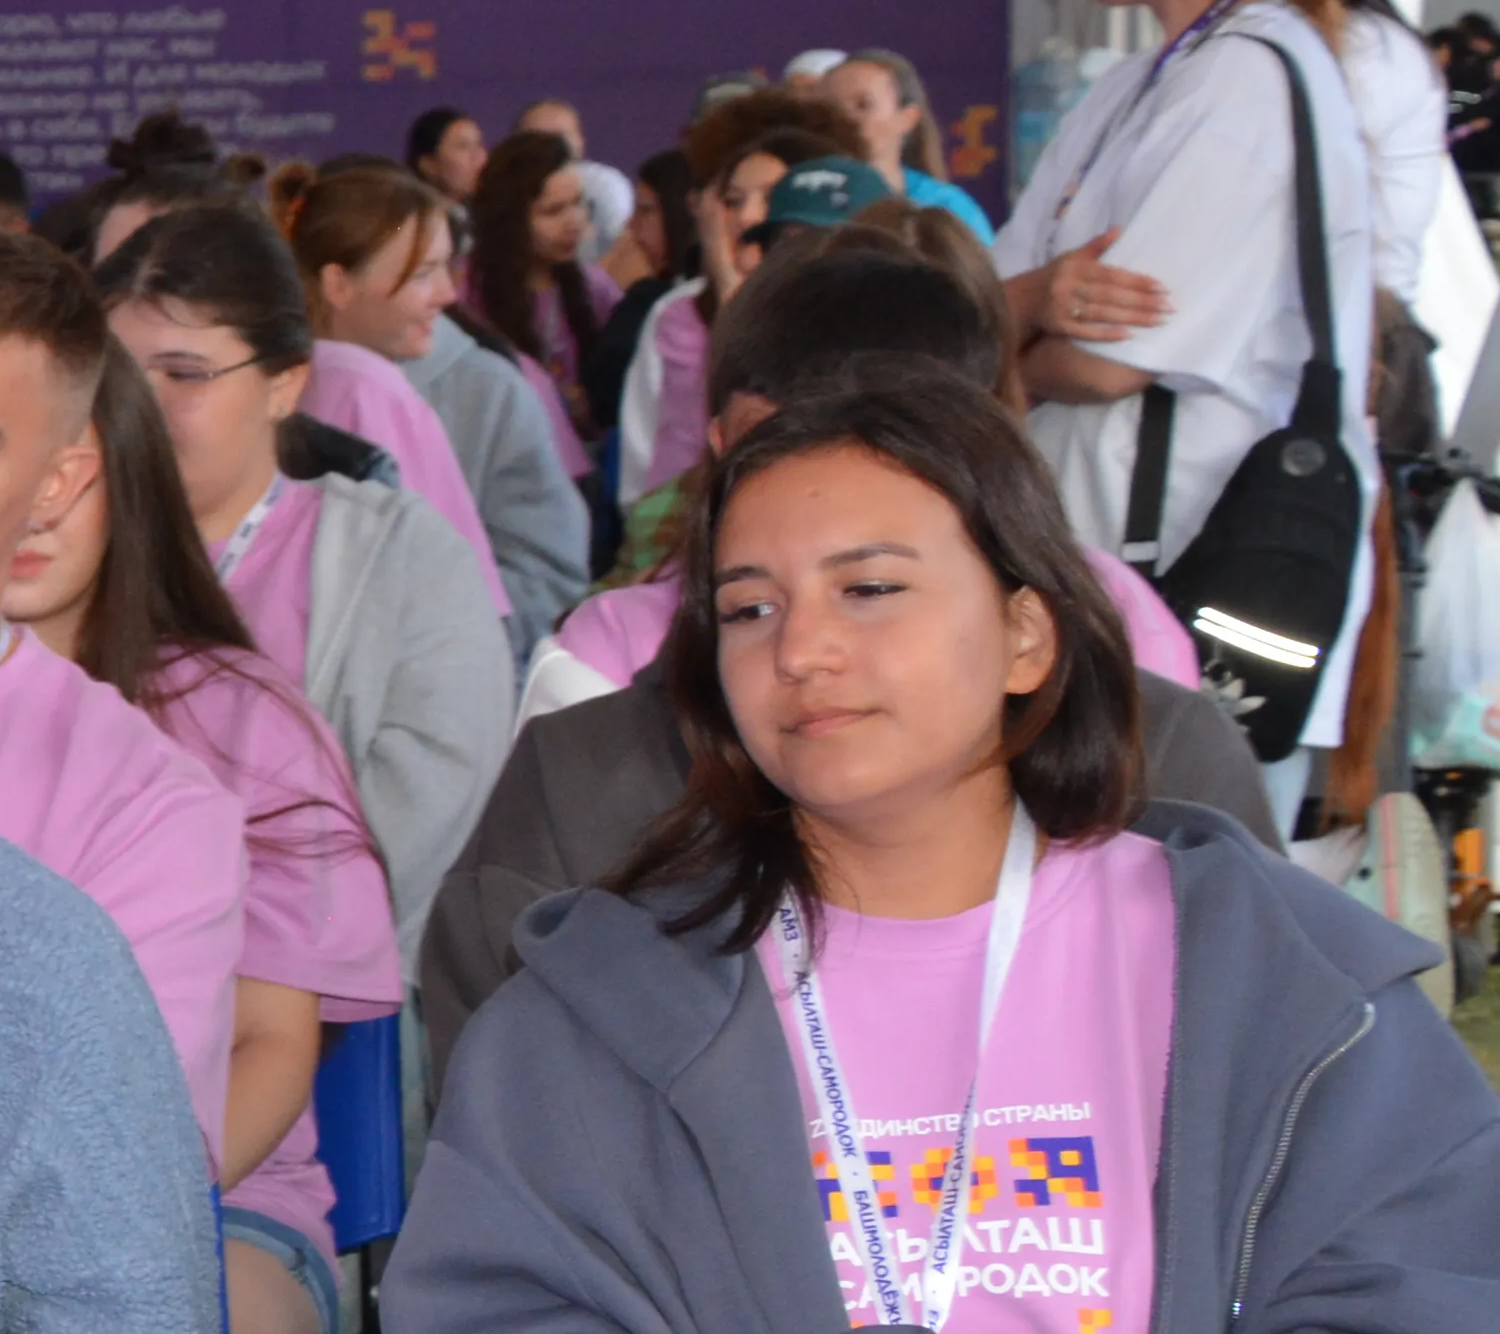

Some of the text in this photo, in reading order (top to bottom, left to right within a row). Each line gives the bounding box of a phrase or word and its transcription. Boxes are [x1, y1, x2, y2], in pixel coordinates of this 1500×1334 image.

[780, 907, 799, 942] АМЗ
[795, 969, 858, 1159] АСЫЛТАШ-САМОРОДОК
[982, 1102, 1092, 1128] СТРАНЫ
